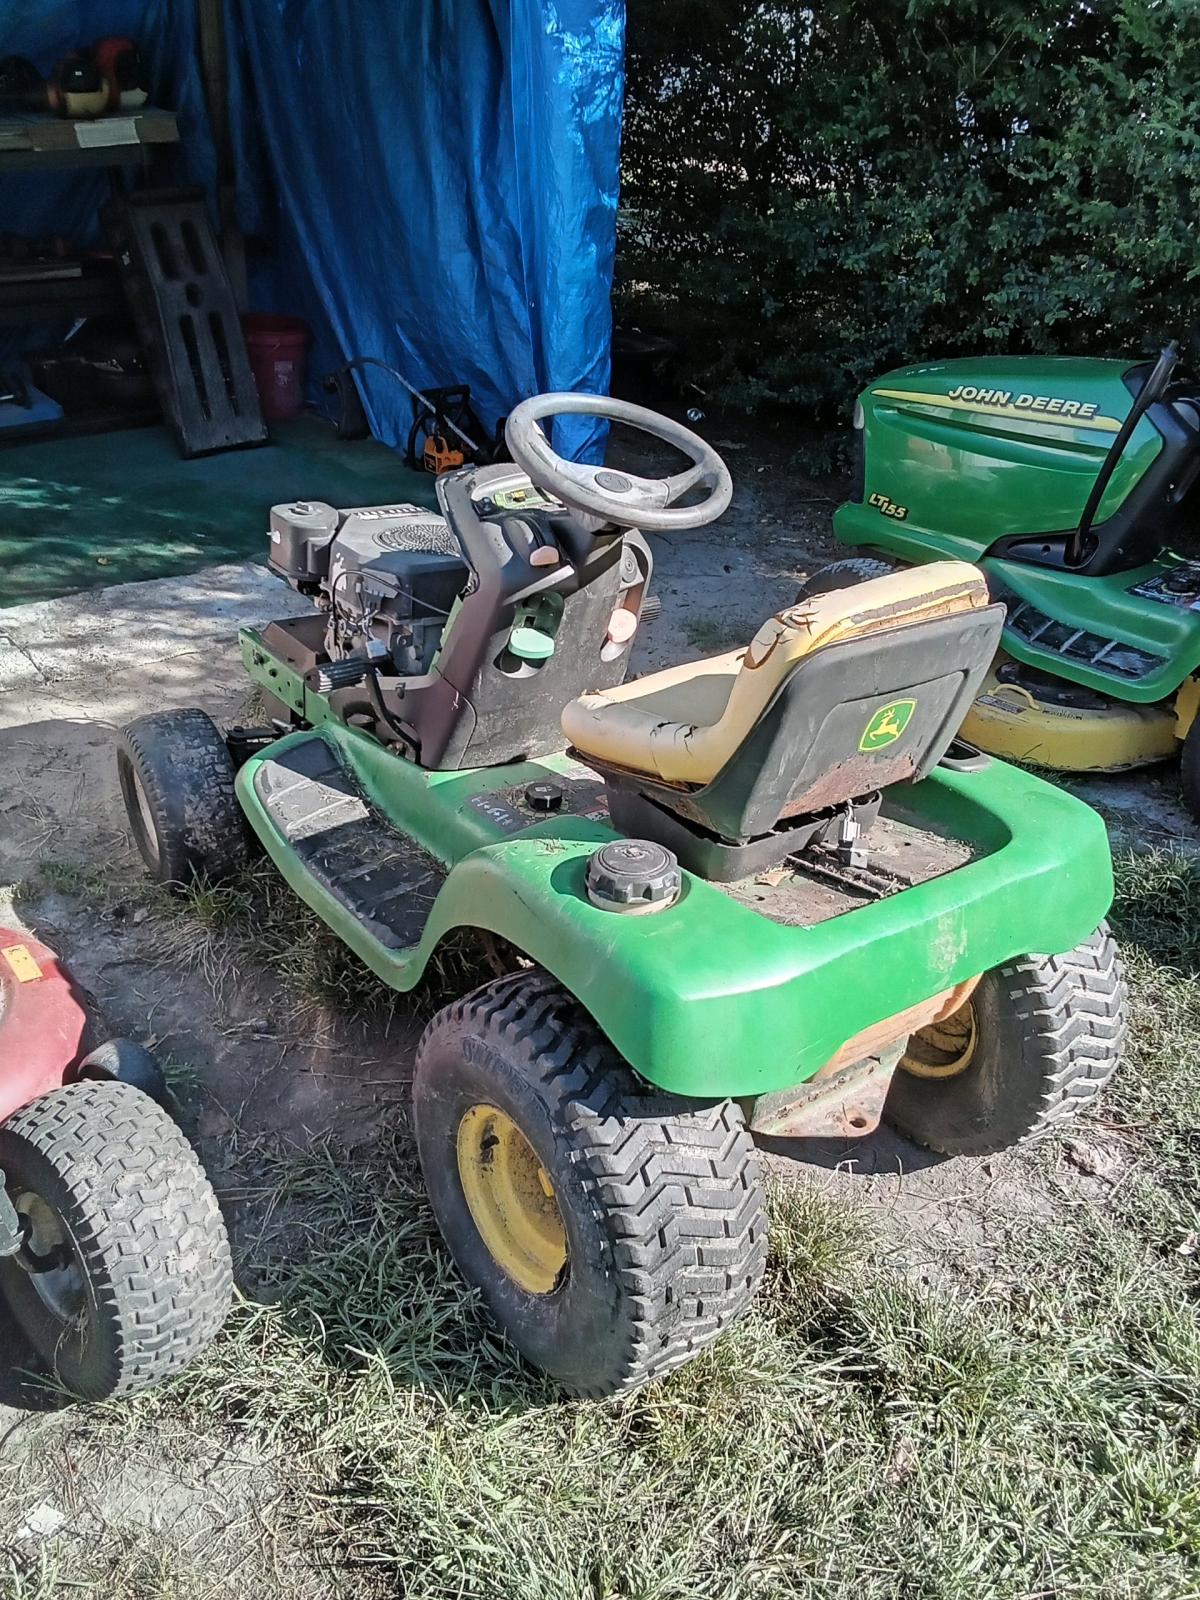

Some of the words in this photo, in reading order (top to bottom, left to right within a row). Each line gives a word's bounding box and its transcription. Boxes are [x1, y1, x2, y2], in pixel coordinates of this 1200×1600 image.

[948, 385, 1012, 406] JOHN
[1014, 393, 1098, 418] DEERE
[868, 492, 907, 518] LT155
